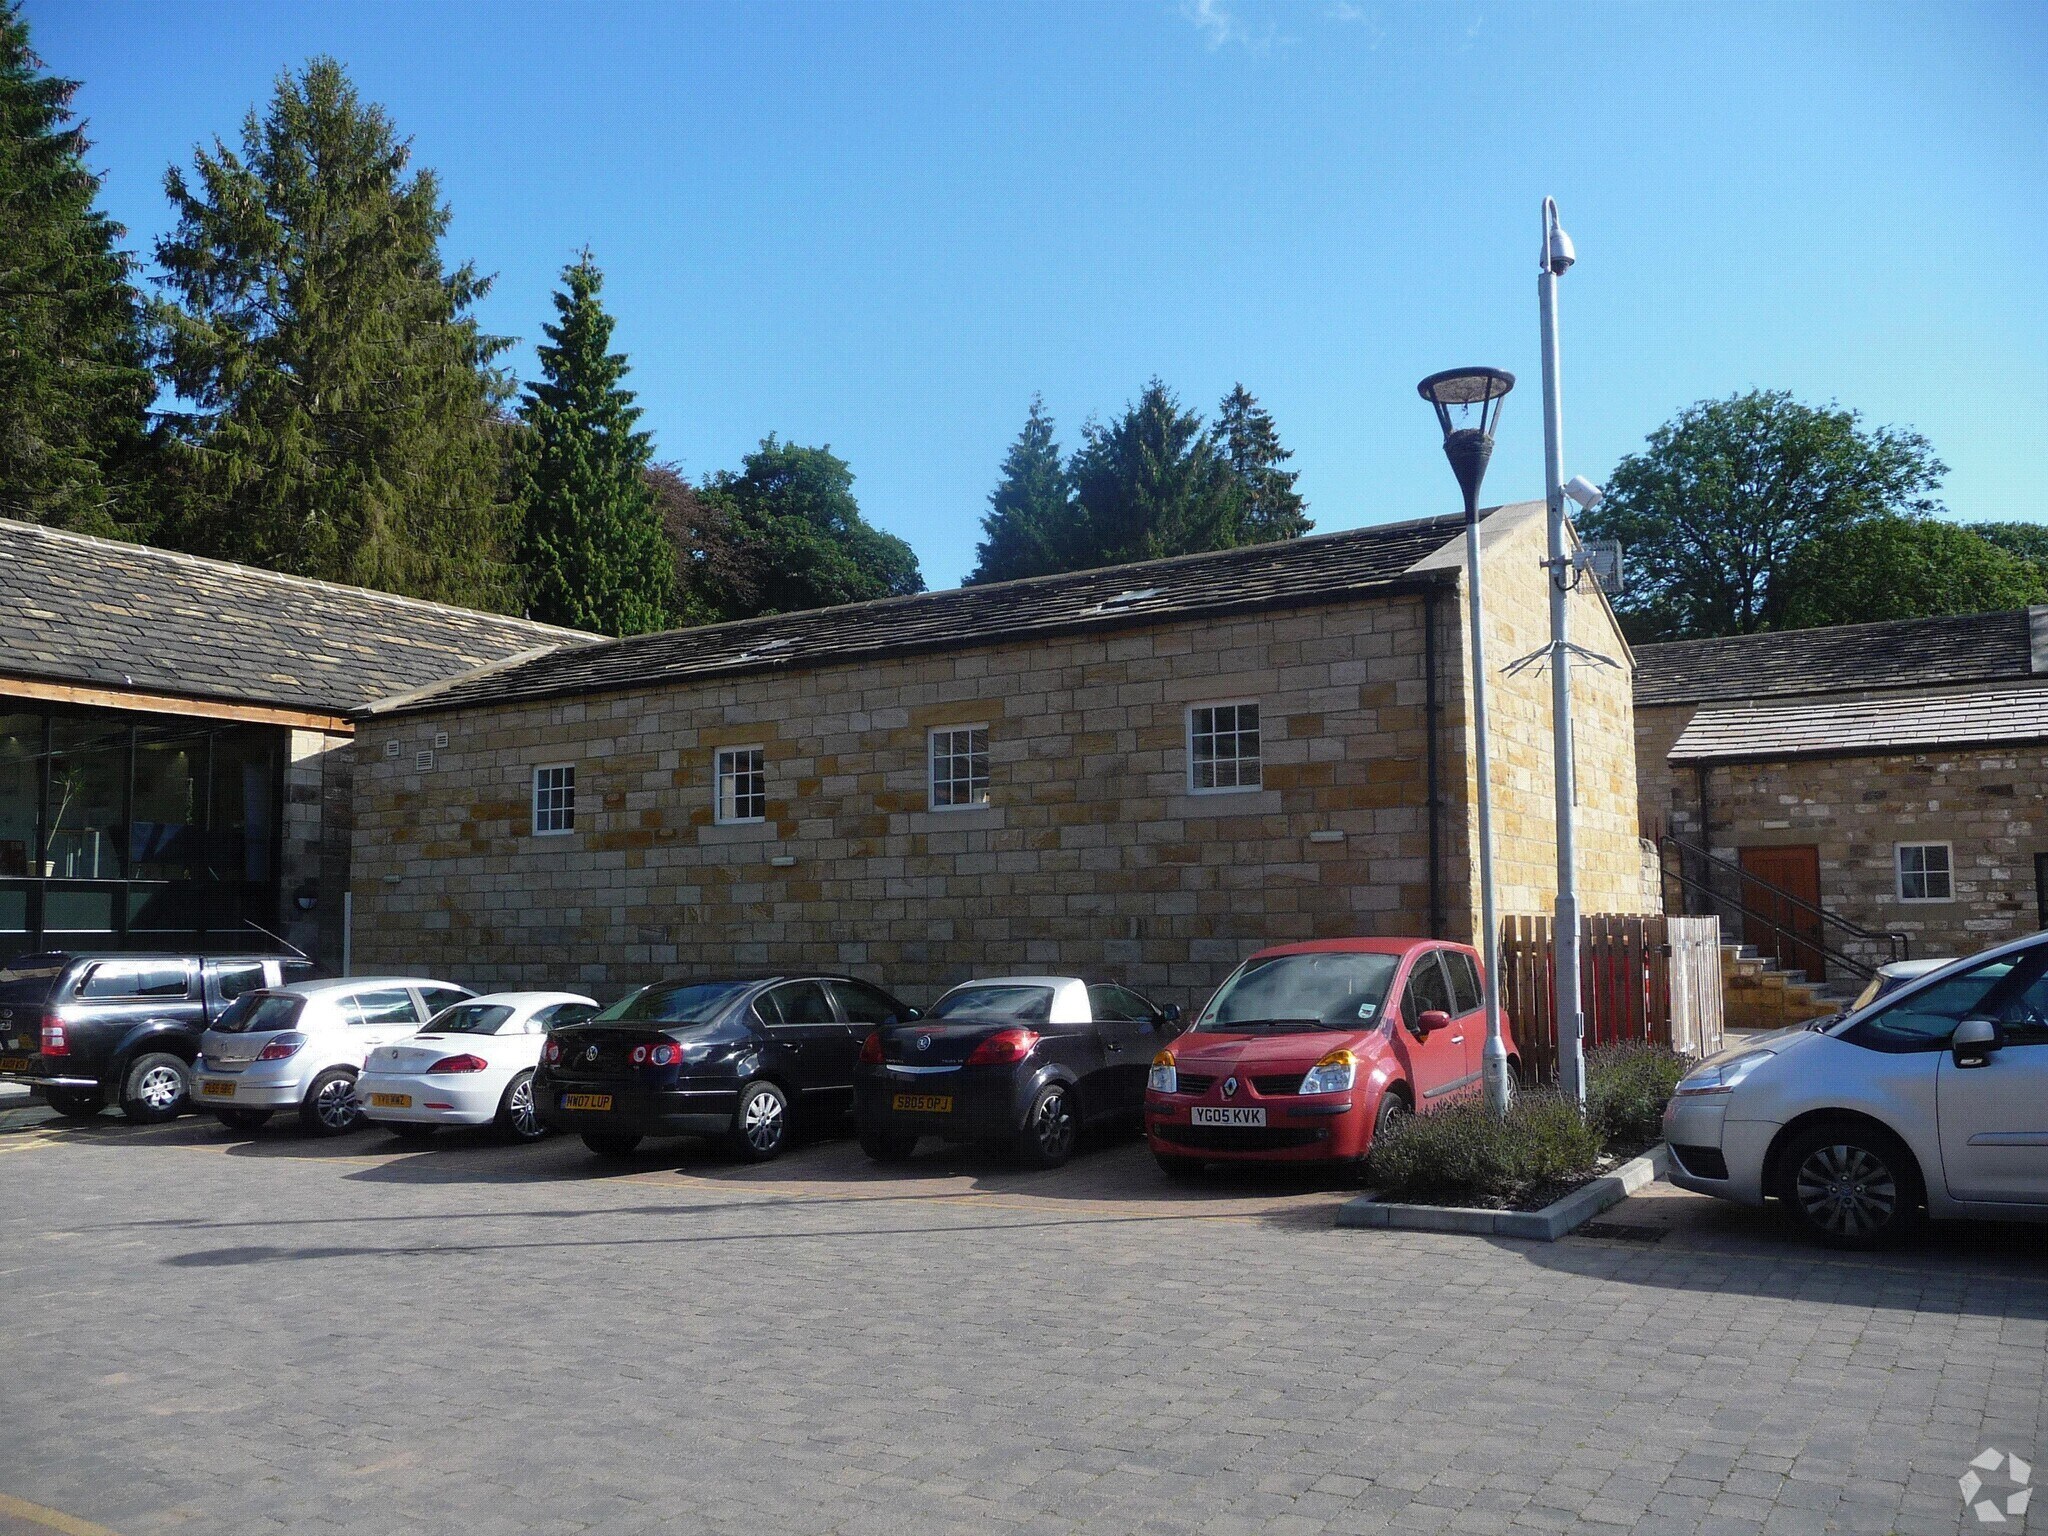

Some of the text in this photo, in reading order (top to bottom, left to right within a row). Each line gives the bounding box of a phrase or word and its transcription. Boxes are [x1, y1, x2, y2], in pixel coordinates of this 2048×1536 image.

[591, 1096, 610, 1108] LUP
[897, 1096, 949, 1110] SB05 OPJ
[1196, 1108, 1261, 1124] YG05 KVK
